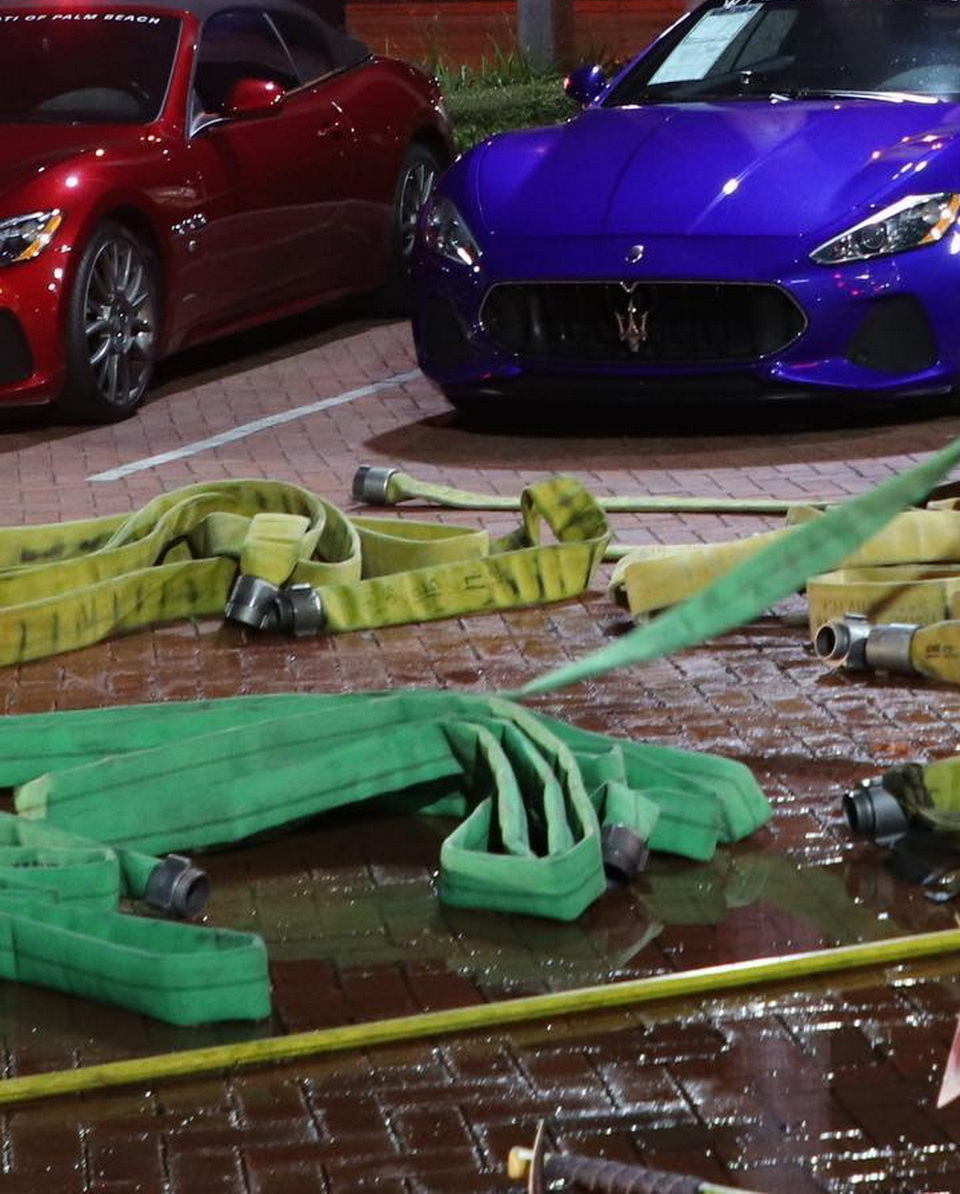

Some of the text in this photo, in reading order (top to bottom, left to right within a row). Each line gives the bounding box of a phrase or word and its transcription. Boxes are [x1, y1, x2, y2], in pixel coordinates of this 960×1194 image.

[24, 14, 47, 22] OF
[51, 13, 98, 21] PALM
[103, 14, 161, 24] BEACH
